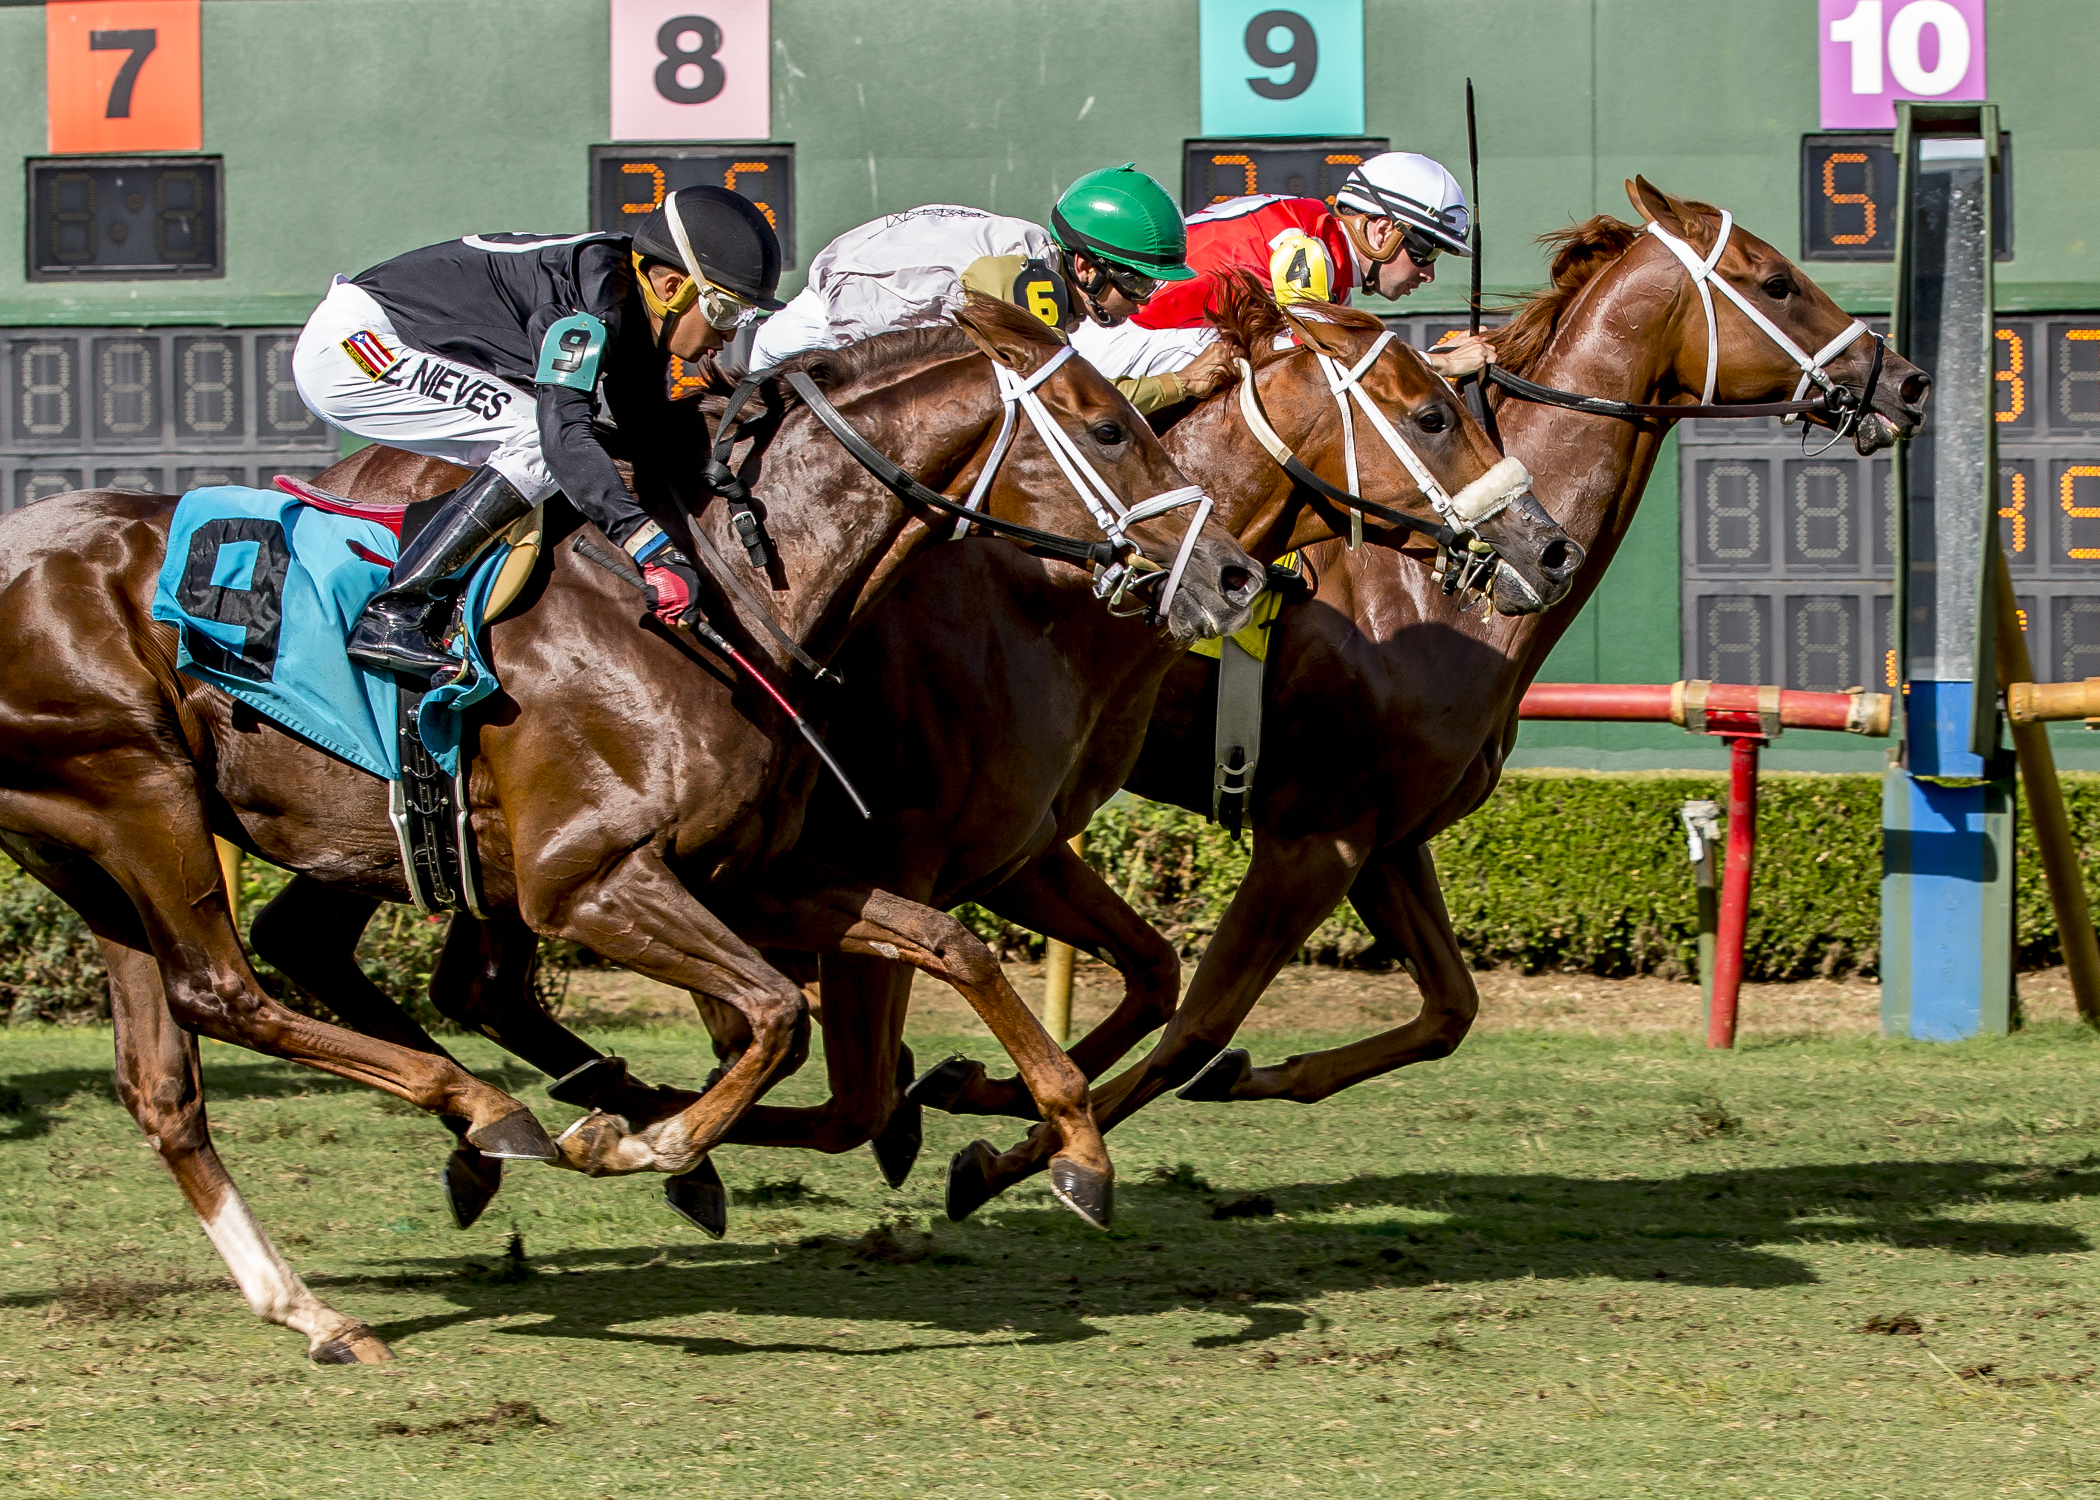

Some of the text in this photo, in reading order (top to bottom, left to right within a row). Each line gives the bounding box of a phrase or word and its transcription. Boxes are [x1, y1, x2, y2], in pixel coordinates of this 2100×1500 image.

[89, 28, 157, 119] 7
[654, 15, 726, 105] 8
[1244, 9, 1318, 101] 9
[1829, 0, 1971, 96] 10
[1822, 153, 1877, 245] 5
[1025, 280, 1059, 326] 6
[1285, 248, 1312, 289] 4
[406, 357, 513, 421] NIEVES
[551, 328, 592, 374] 9
[174, 516, 292, 685] 9
